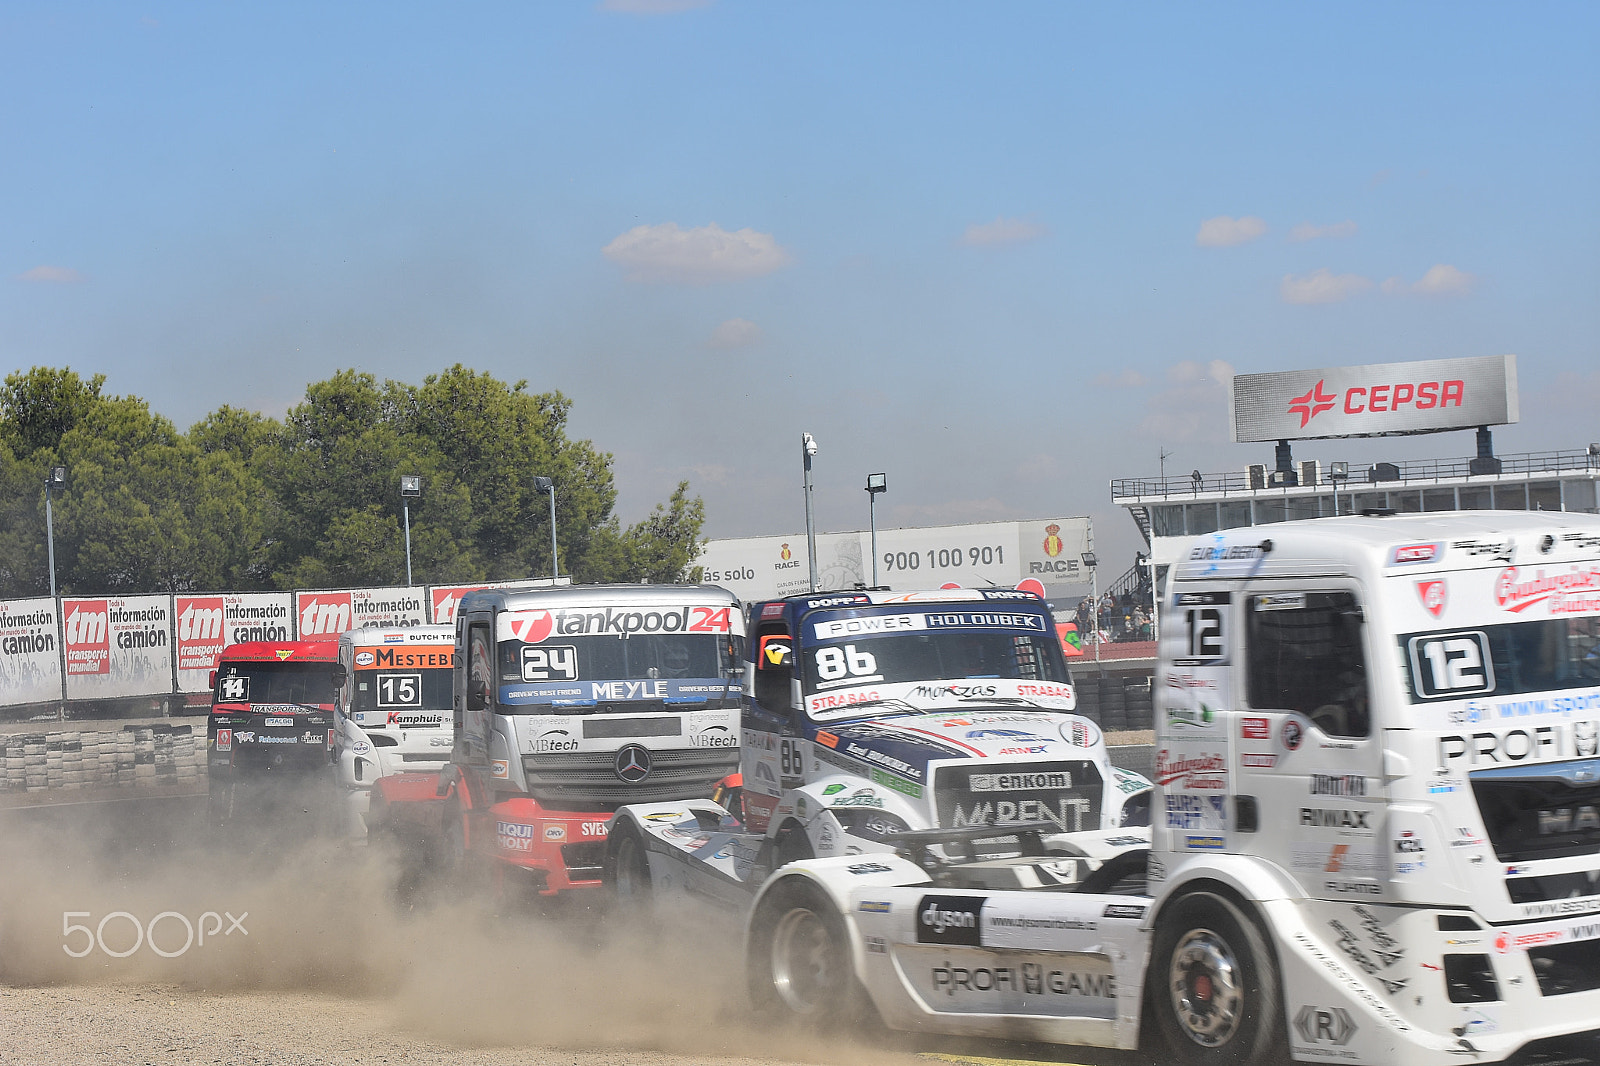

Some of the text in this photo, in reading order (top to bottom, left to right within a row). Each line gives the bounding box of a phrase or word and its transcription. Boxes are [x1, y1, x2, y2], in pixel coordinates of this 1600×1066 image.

[1343, 379, 1464, 415] CEPSA
[774, 560, 800, 571] RACE
[883, 545, 1004, 572] 900 100 901
[1029, 559, 1079, 574] RACE
[703, 566, 755, 582] ás solo
[109, 606, 166, 623] información
[225, 603, 287, 619] información
[353, 597, 420, 614] información
[66, 604, 107, 646] tm
[178, 601, 223, 642] tm
[301, 597, 350, 637] tm
[555, 607, 732, 637] tankpool24
[829, 613, 1038, 635] POWER HOLOUBEK
[2, 628, 54, 655] camión
[117, 625, 167, 649] camión
[233, 621, 287, 645] camión
[1185, 609, 1224, 656] 12
[68, 648, 108, 664] transporte
[180, 643, 224, 657] transporte
[376, 648, 455, 667] MESTEB
[69, 659, 101, 673] mundial
[180, 655, 216, 668] mundial
[524, 649, 574, 679] 24
[814, 645, 878, 681] 86
[1424, 638, 1486, 690] 12
[222, 678, 245, 698] 14
[382, 678, 415, 702] 15
[556, 688, 582, 697] FRIEND
[591, 681, 669, 700] MEYLE
[1016, 684, 1072, 699] STRABAG
[811, 691, 880, 710] STRABAG
[386, 711, 443, 725] Kamphuis
[528, 717, 570, 727] Engineered
[689, 713, 730, 722] Engineered
[528, 728, 539, 737] by
[689, 723, 699, 732] by
[527, 738, 579, 752] MBtech
[688, 733, 737, 747] MBtech
[1435, 725, 1563, 765] PROFI
[781, 739, 802, 774] 86
[999, 745, 1049, 756] ARMEX
[999, 772, 1066, 790] enkom
[497, 822, 533, 838] LIQUI
[546, 829, 565, 837] DKV
[498, 836, 532, 850] MOLY
[921, 902, 977, 934] dyson
[931, 967, 1018, 993] PROFI
[1046, 970, 1119, 999] GAME
